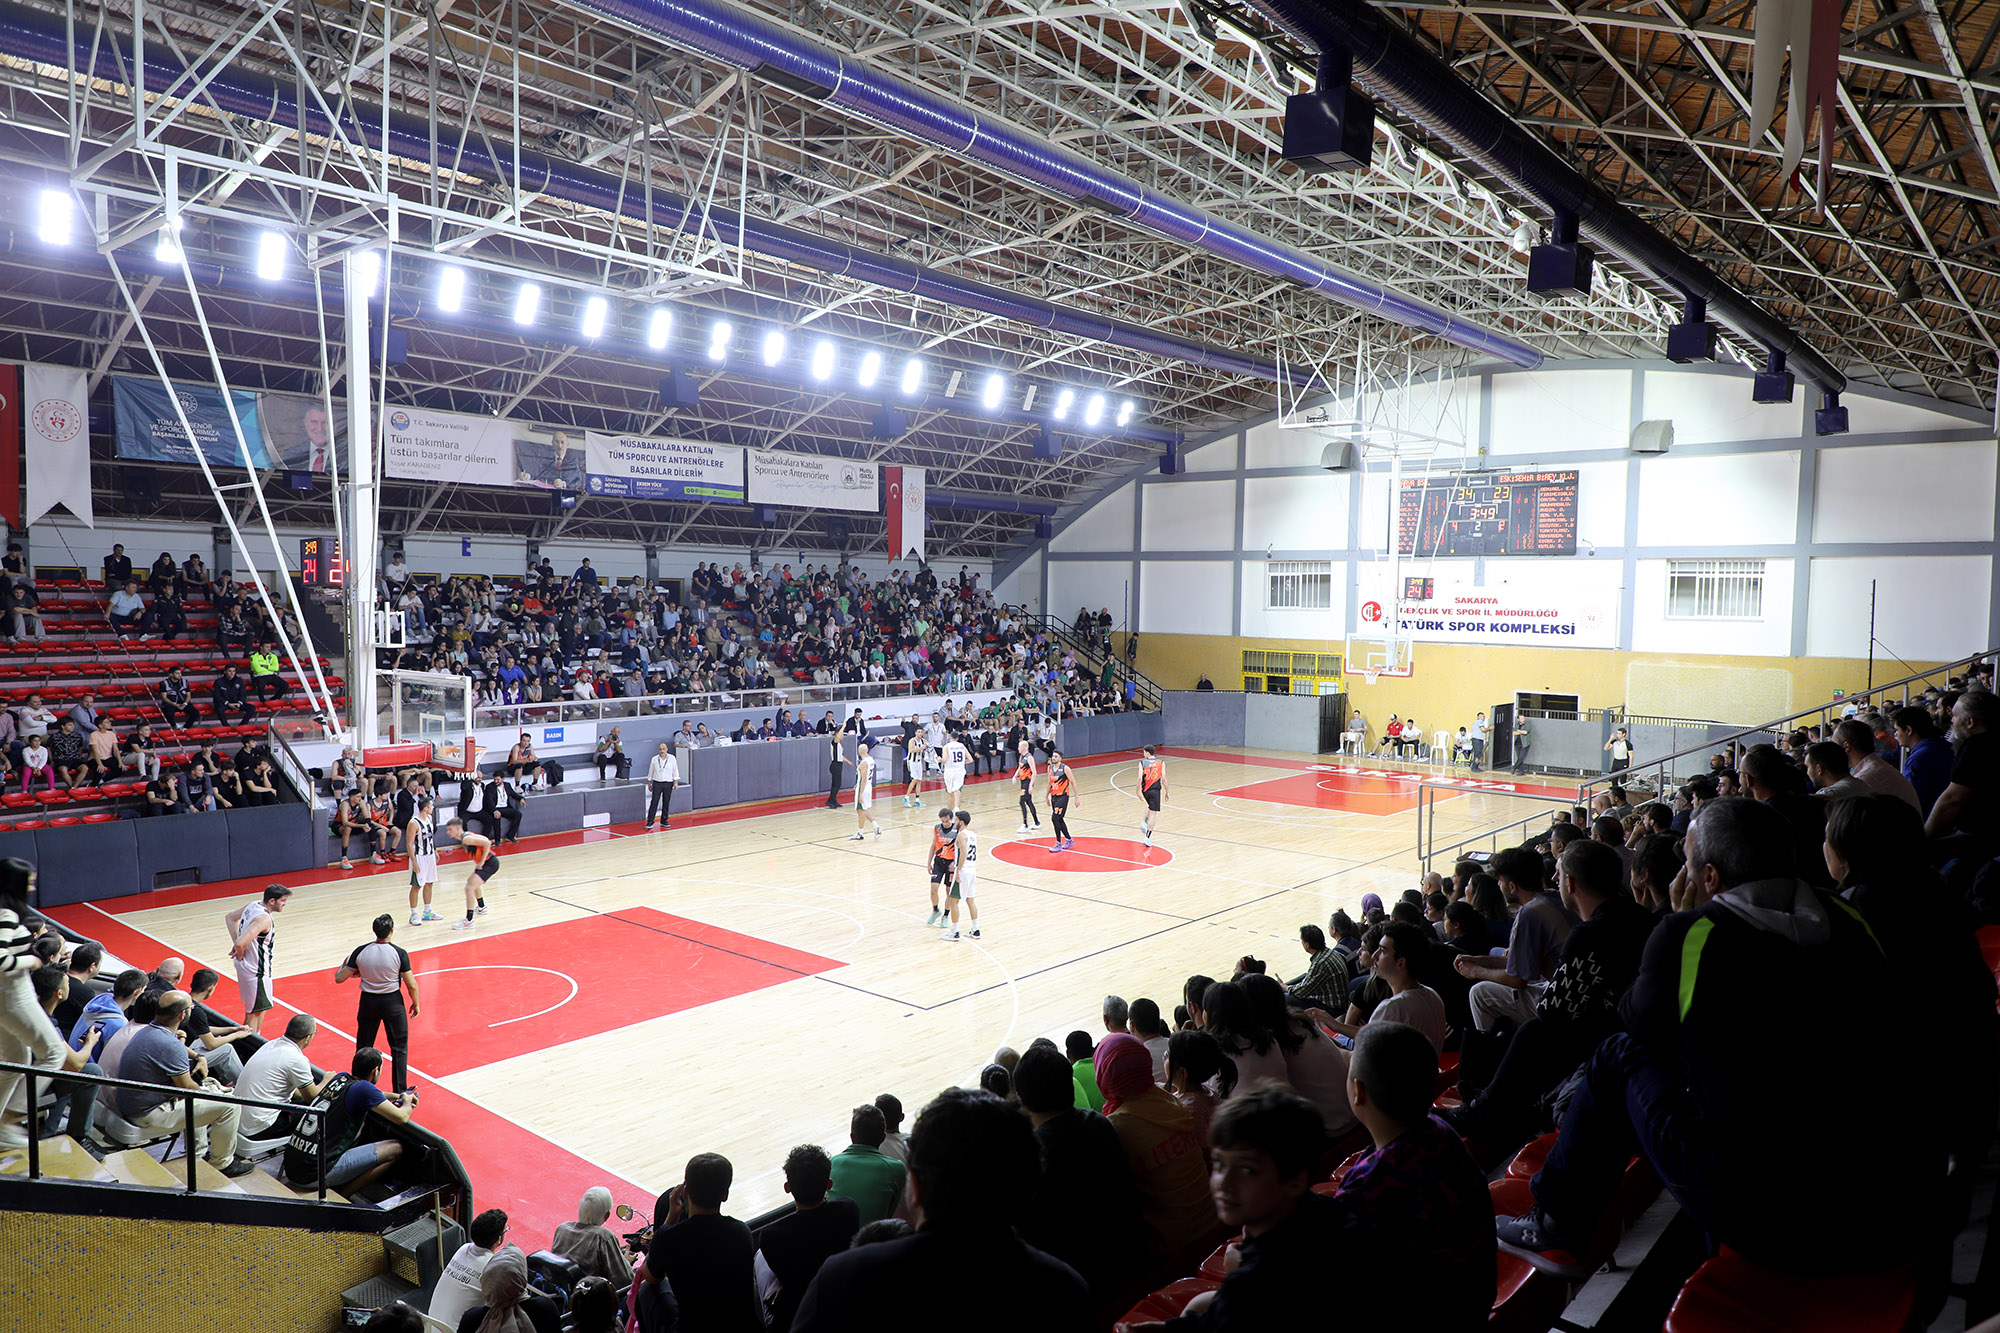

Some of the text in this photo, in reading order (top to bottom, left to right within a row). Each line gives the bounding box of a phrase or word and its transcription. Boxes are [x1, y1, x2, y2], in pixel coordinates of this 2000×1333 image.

[149, 423, 221, 437] VE SPORCUARIMIZA
[156, 418, 213, 430] TÜM ANRENÖR
[425, 421, 449, 430] Sakarya
[152, 431, 185, 439] BAŞARILAR
[390, 434, 460, 450] Tüm takımlara
[620, 439, 714, 455] MÜSABAKALARA KATILAN
[390, 447, 499, 465] üstün başarılar dilerim.
[608, 450, 725, 469] TÜM SPORCU VE ANTRENÖRLERE
[754, 455, 823, 470] Müsabakalara Katılan
[630, 465, 703, 478] BAŞARILAR DİLERİM
[754, 465, 779, 476] Sporcu
[788, 468, 830, 481] Antrenörlere
[1458, 487, 1510, 500] 34 23
[1470, 508, 1496, 520] 3:49
[1451, 521, 1459, 531] 4
[1475, 521, 1481, 531] 2
[462, 537, 471, 556] E
[799, 551, 806, 564] F
[303, 559, 317, 583] 24
[1407, 585, 1422, 599] 24
[1455, 596, 1499, 605] SAKARYA
[1442, 608, 1454, 616] VE
[1456, 608, 1482, 617] SPOR
[1484, 607, 1494, 616] İL
[1496, 608, 1559, 618] MÜDÜRLÜĞÜ
[1448, 621, 1486, 632] SPOR
[1490, 622, 1576, 635] KOMPLEKSİ
[953, 751, 963, 763] 19
[966, 844, 977, 862] 23
